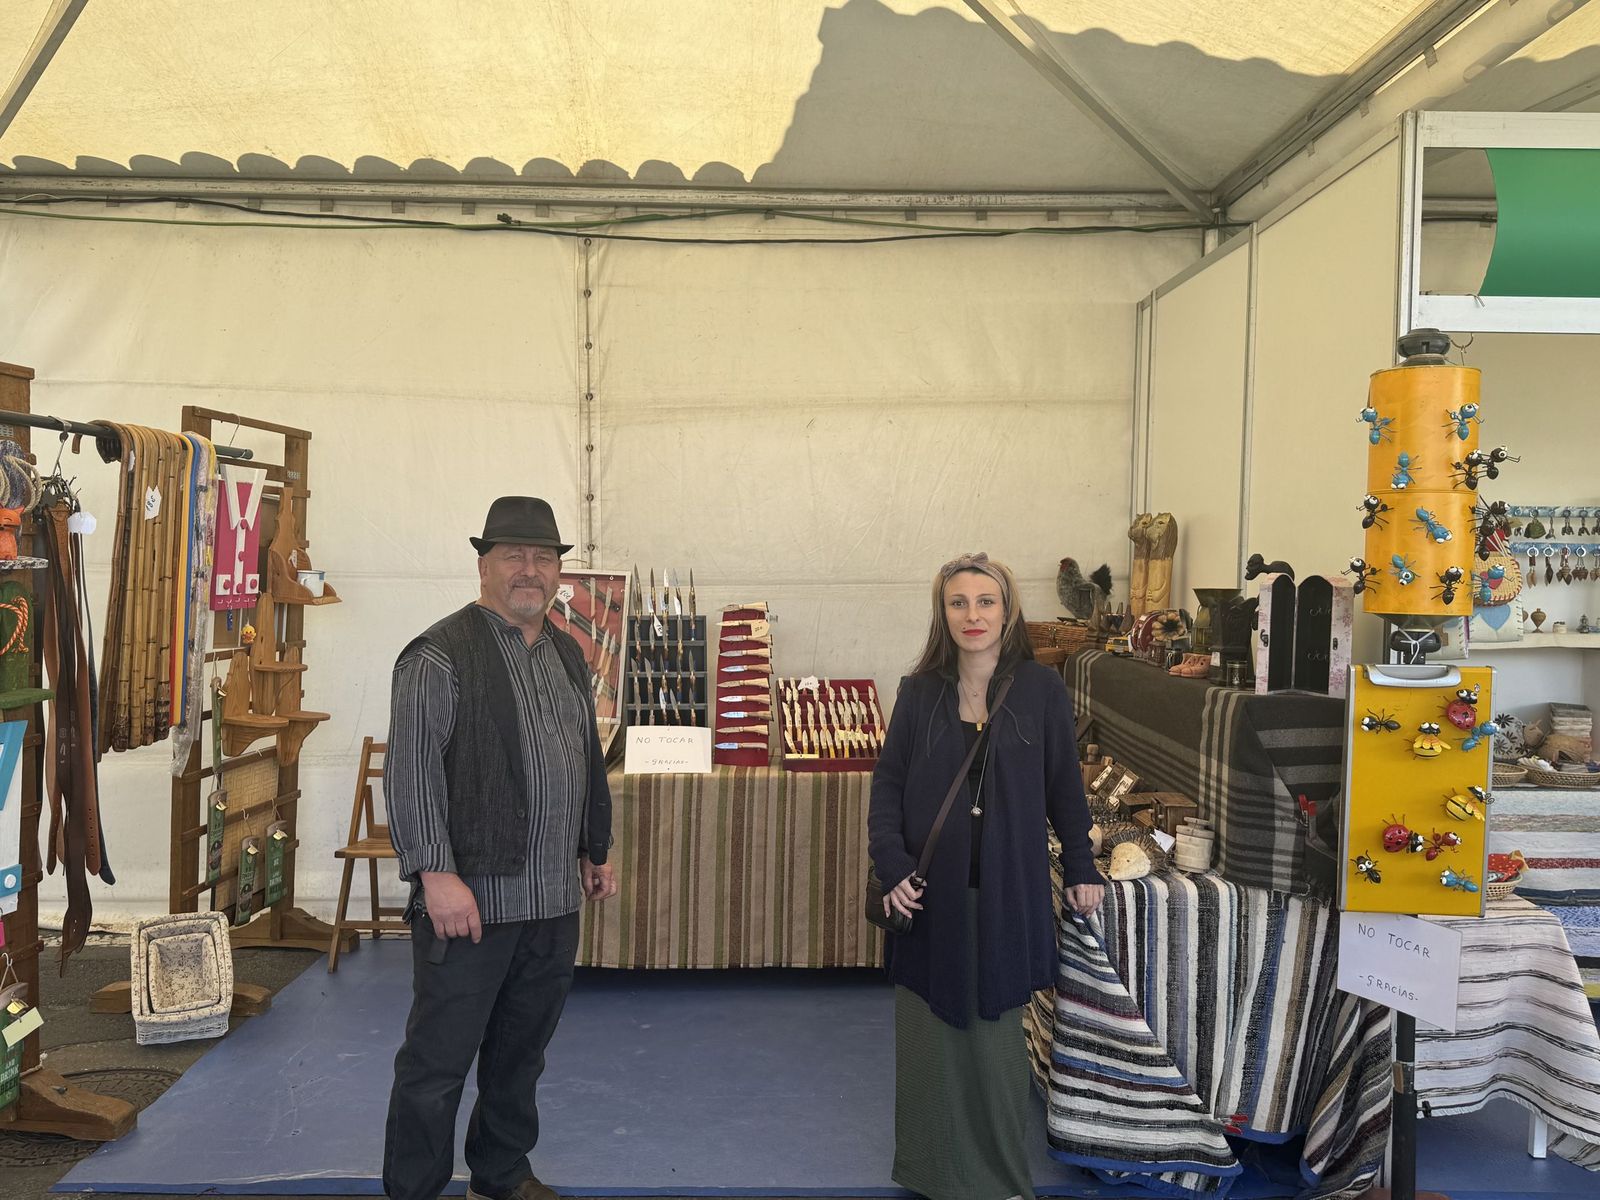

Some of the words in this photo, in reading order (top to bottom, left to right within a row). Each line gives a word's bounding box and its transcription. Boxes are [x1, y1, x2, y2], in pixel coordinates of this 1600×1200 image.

[635, 736, 651, 744] NO
[658, 736, 695, 744] TOCAR
[1358, 923, 1376, 938] NO
[1388, 933, 1431, 959] TOCAR
